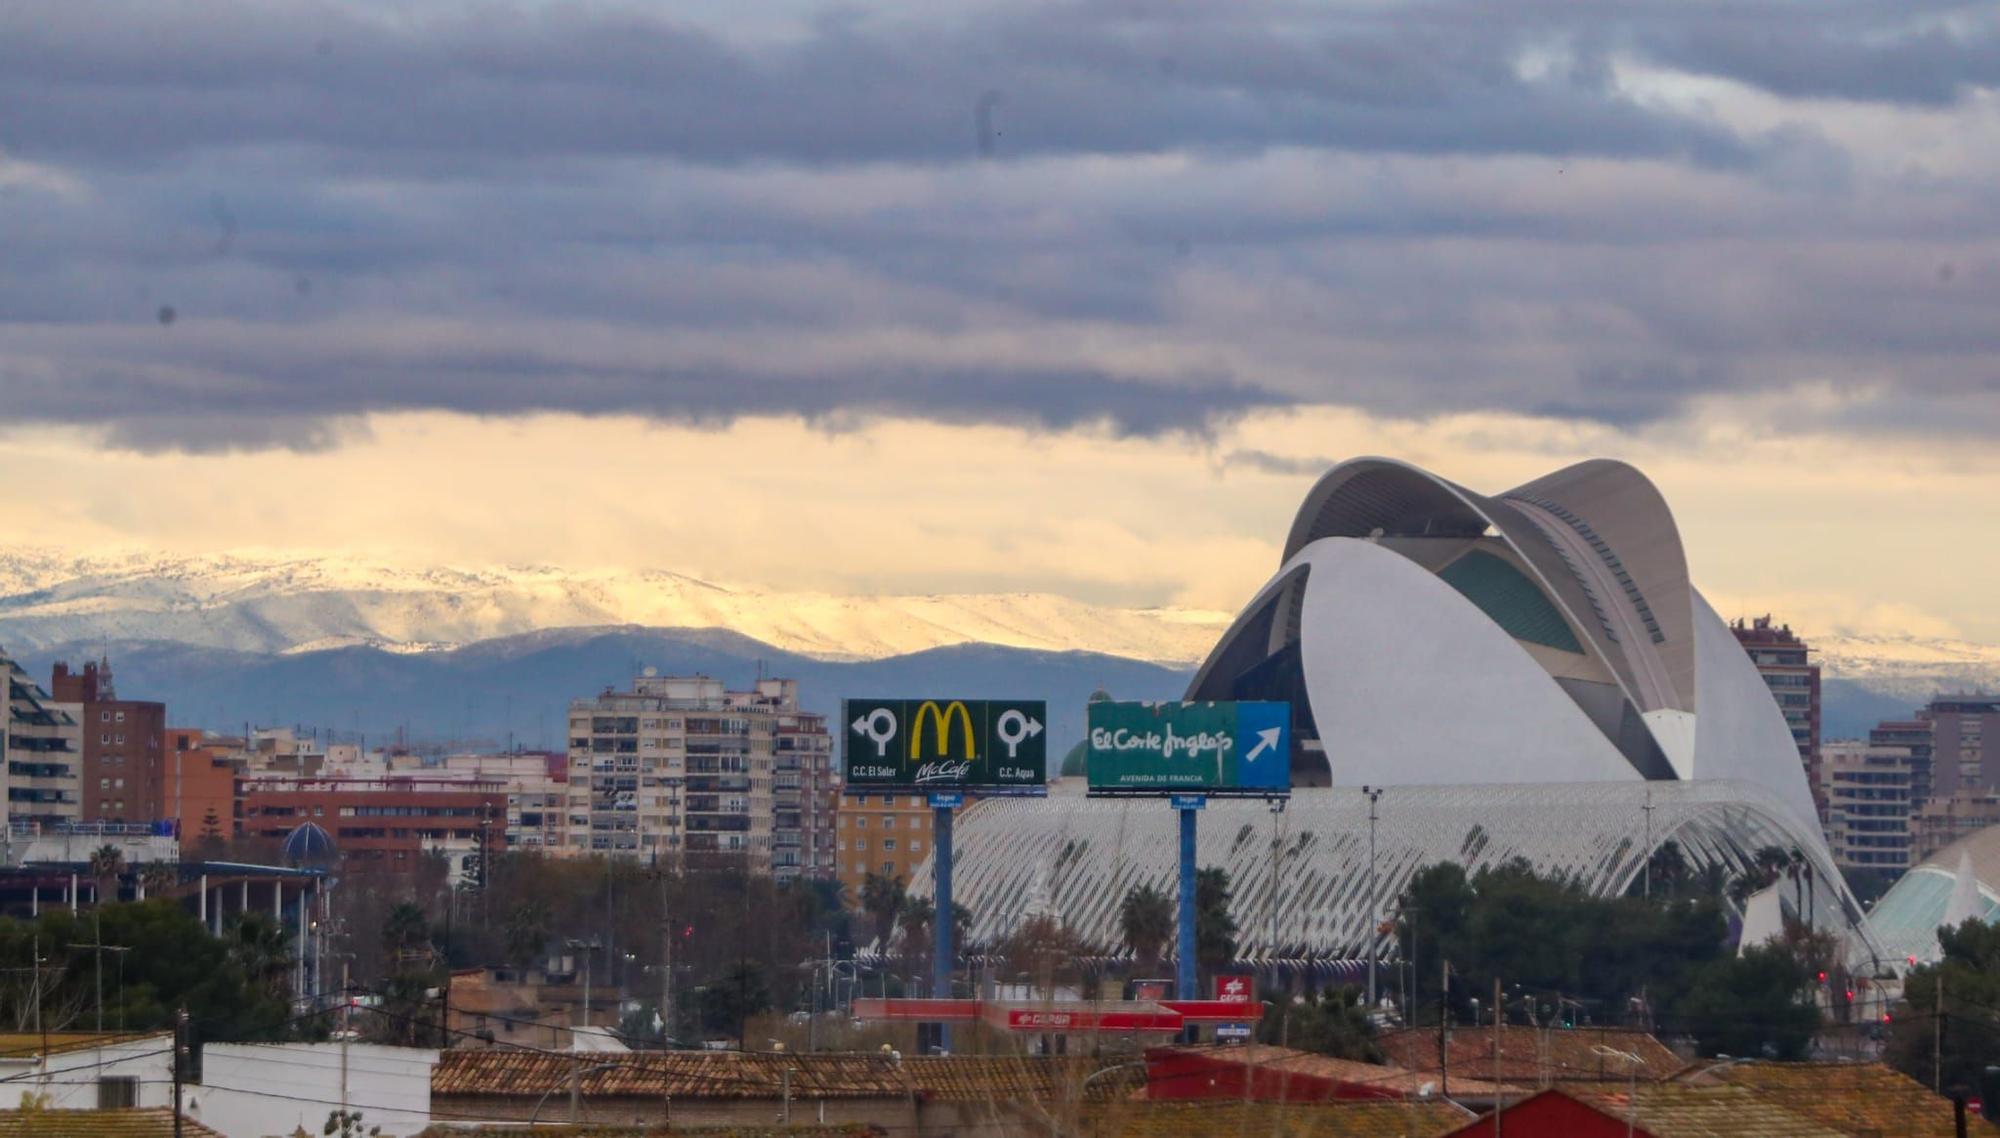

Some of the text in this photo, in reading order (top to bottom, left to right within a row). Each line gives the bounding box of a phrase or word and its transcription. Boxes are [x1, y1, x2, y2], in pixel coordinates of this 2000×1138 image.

[1091, 727, 1112, 750] El
[1113, 728, 1161, 750] Corte
[852, 766, 867, 777] C.C.
[868, 766, 876, 777] El
[999, 767, 1014, 778] C.C.
[1120, 775, 1203, 783] AVENIDA DE FRANCIA
